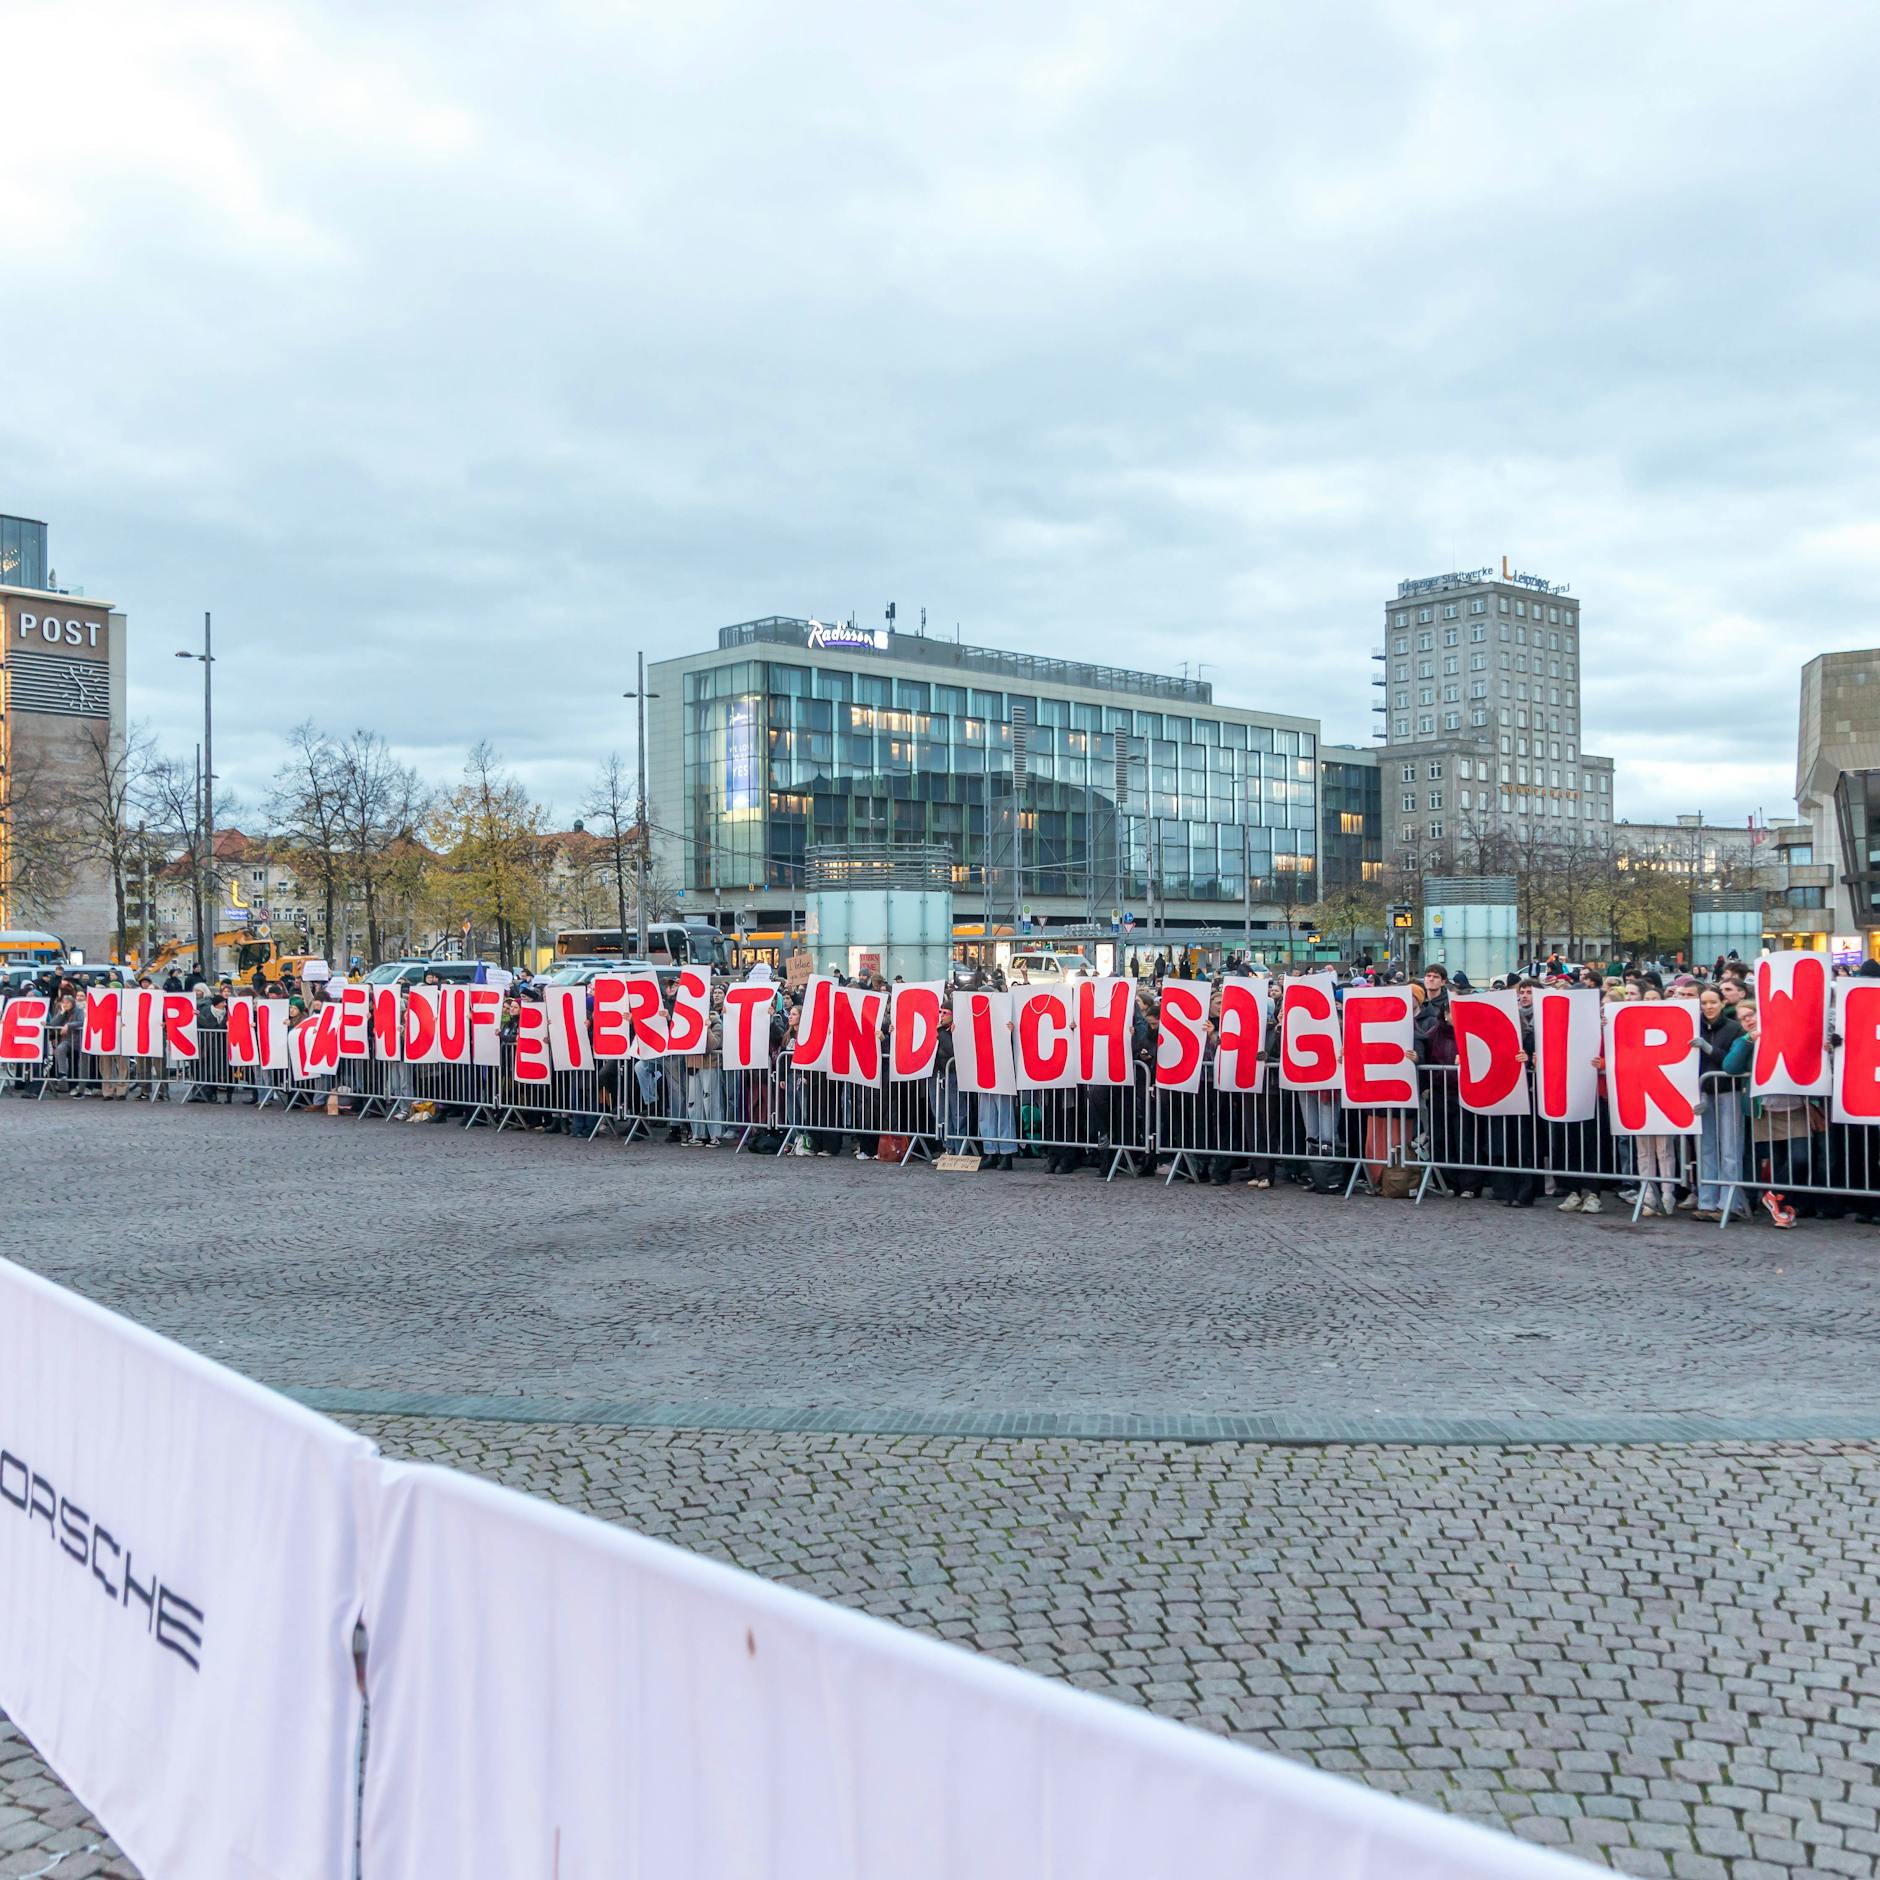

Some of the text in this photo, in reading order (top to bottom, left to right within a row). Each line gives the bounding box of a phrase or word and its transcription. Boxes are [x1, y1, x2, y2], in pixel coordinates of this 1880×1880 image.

[1443, 566, 1493, 585] Stadtwerke
[20, 613, 101, 647] POST
[808, 619, 874, 649] Radisson
[85, 993, 198, 1057] MIR
[405, 990, 465, 1061] DU
[471, 973, 775, 1080] FEIERST
[971, 982, 1130, 1090] ICH
[1155, 985, 1412, 1103] SAGE
[1450, 996, 1695, 1131] DIR
[0, 1448, 205, 1674] ORSCHE
